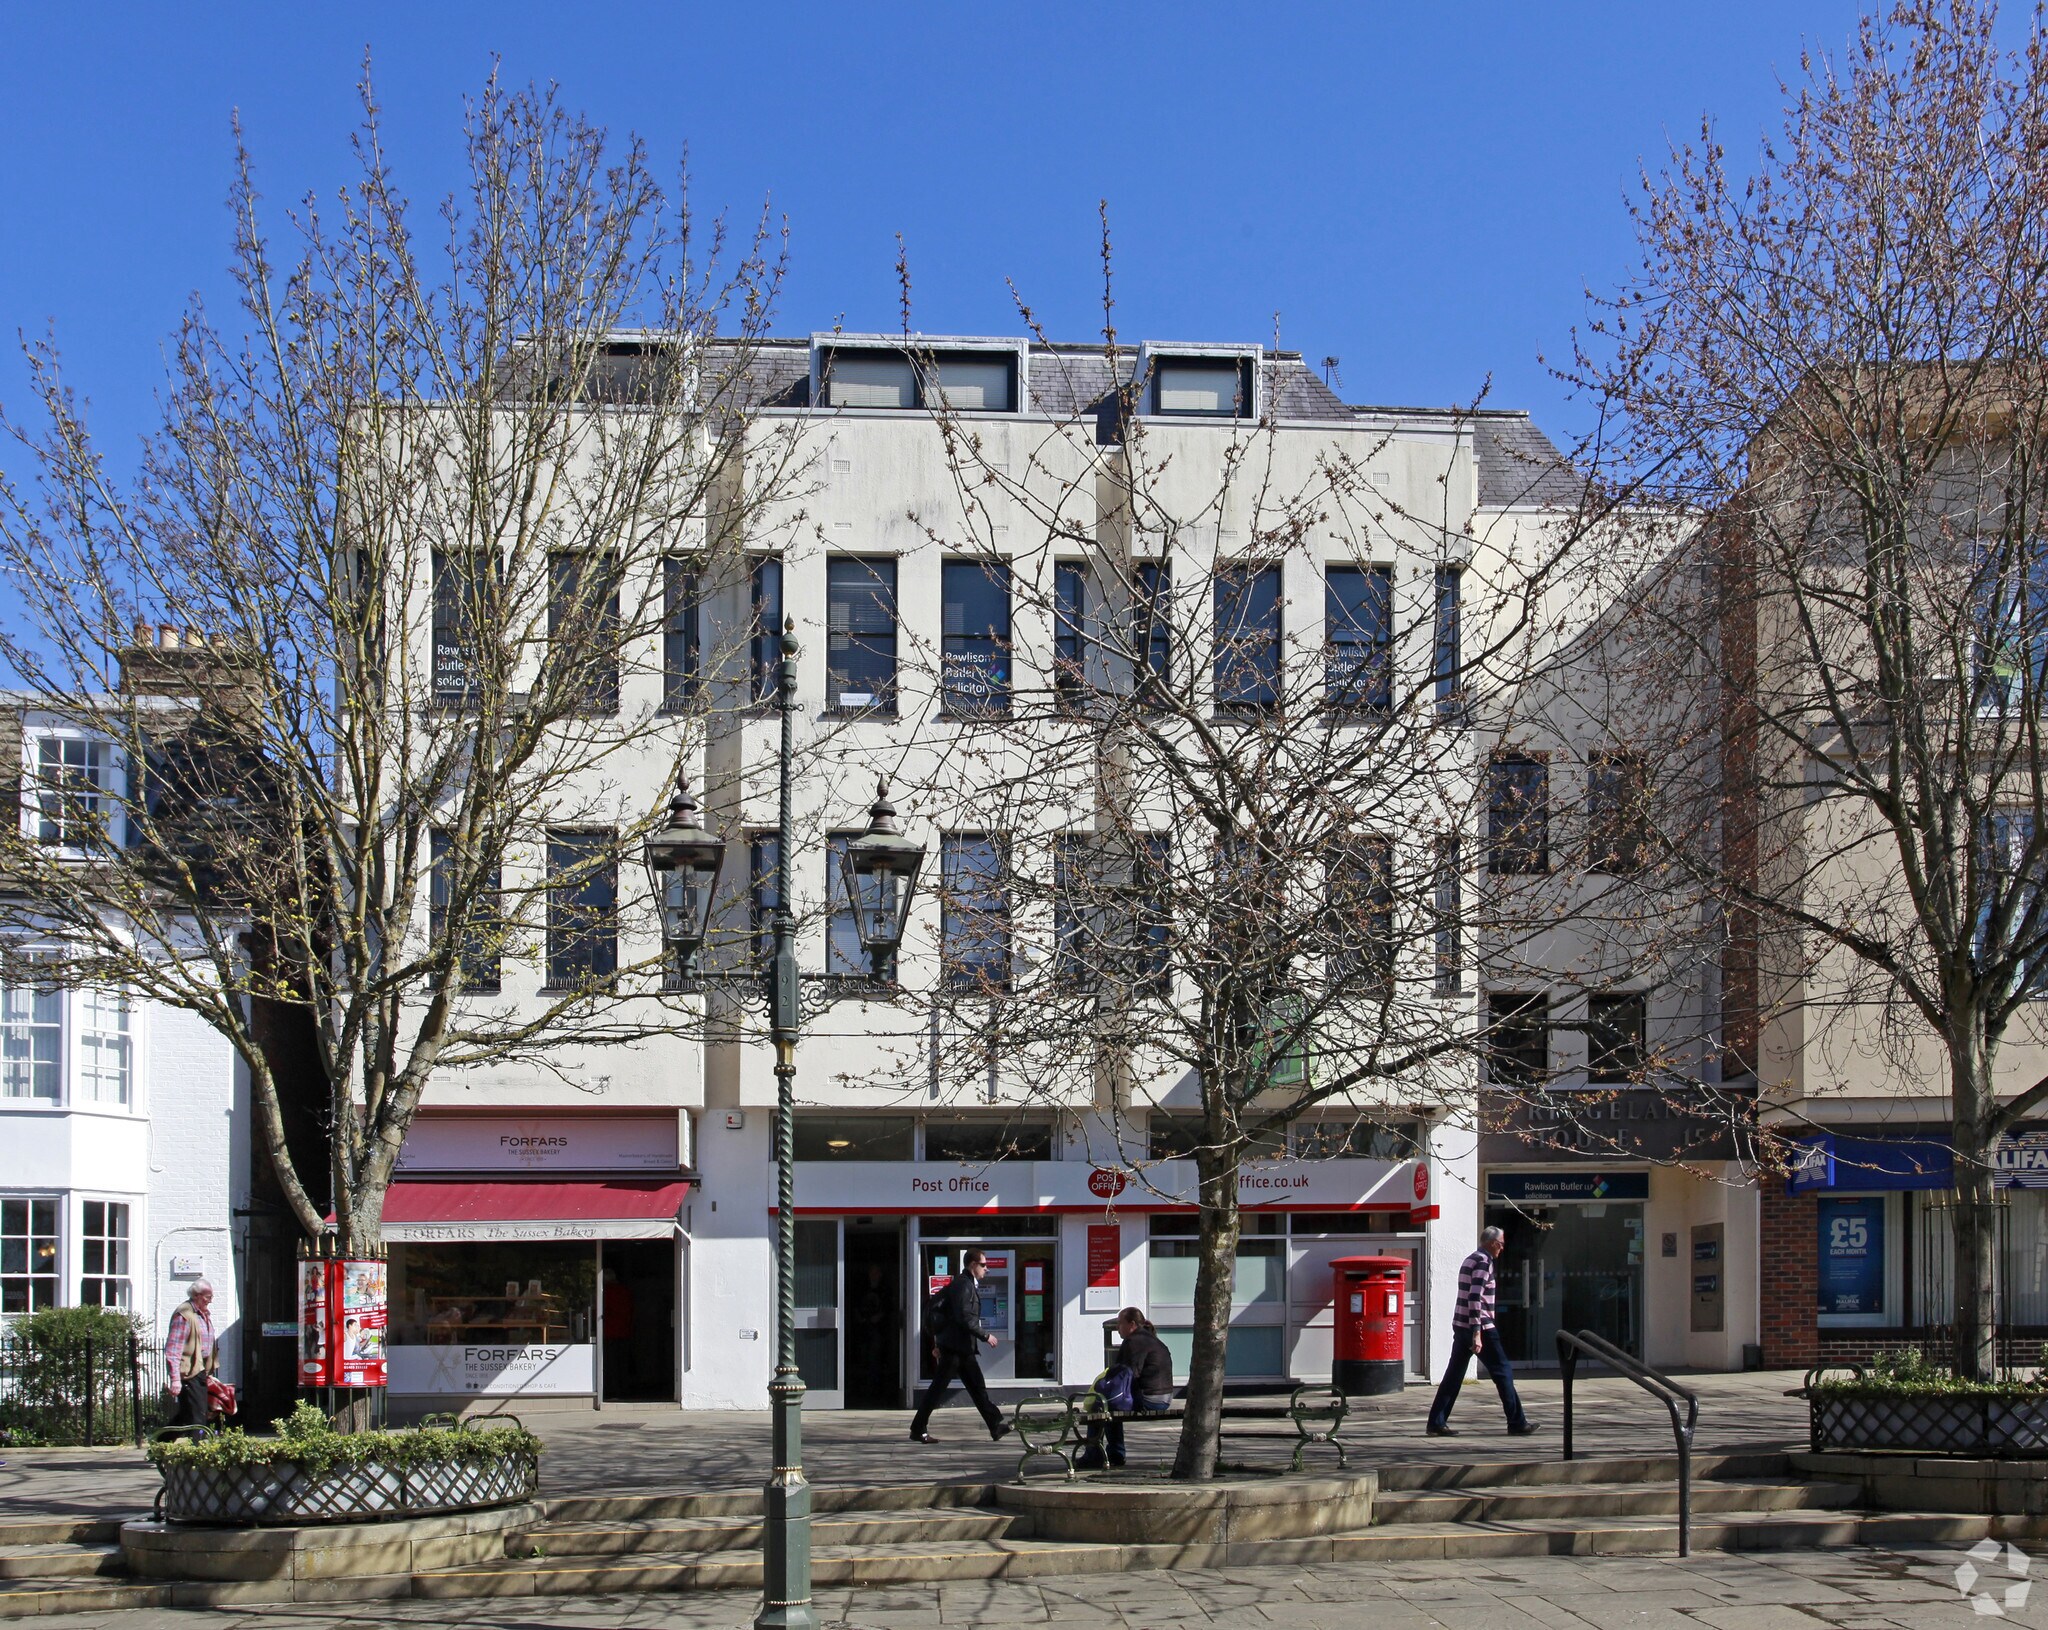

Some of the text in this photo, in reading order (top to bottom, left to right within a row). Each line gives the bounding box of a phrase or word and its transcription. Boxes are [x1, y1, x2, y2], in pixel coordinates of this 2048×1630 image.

[437, 659, 466, 671] Butle
[500, 1136, 568, 1146] FORFARS
[912, 1178, 990, 1192] Post Office
[1092, 1182, 1122, 1190] OFFICE
[1240, 1174, 1309, 1188] ffice.co.uk
[1524, 1182, 1558, 1190] Rawlison
[1560, 1182, 1583, 1190] Butler
[403, 1226, 597, 1239] FORFARS The Sussex Bakery
[1830, 1218, 1868, 1248] £5
[465, 1348, 557, 1361] FORFARS
[480, 1363, 508, 1371] SUSSEX
